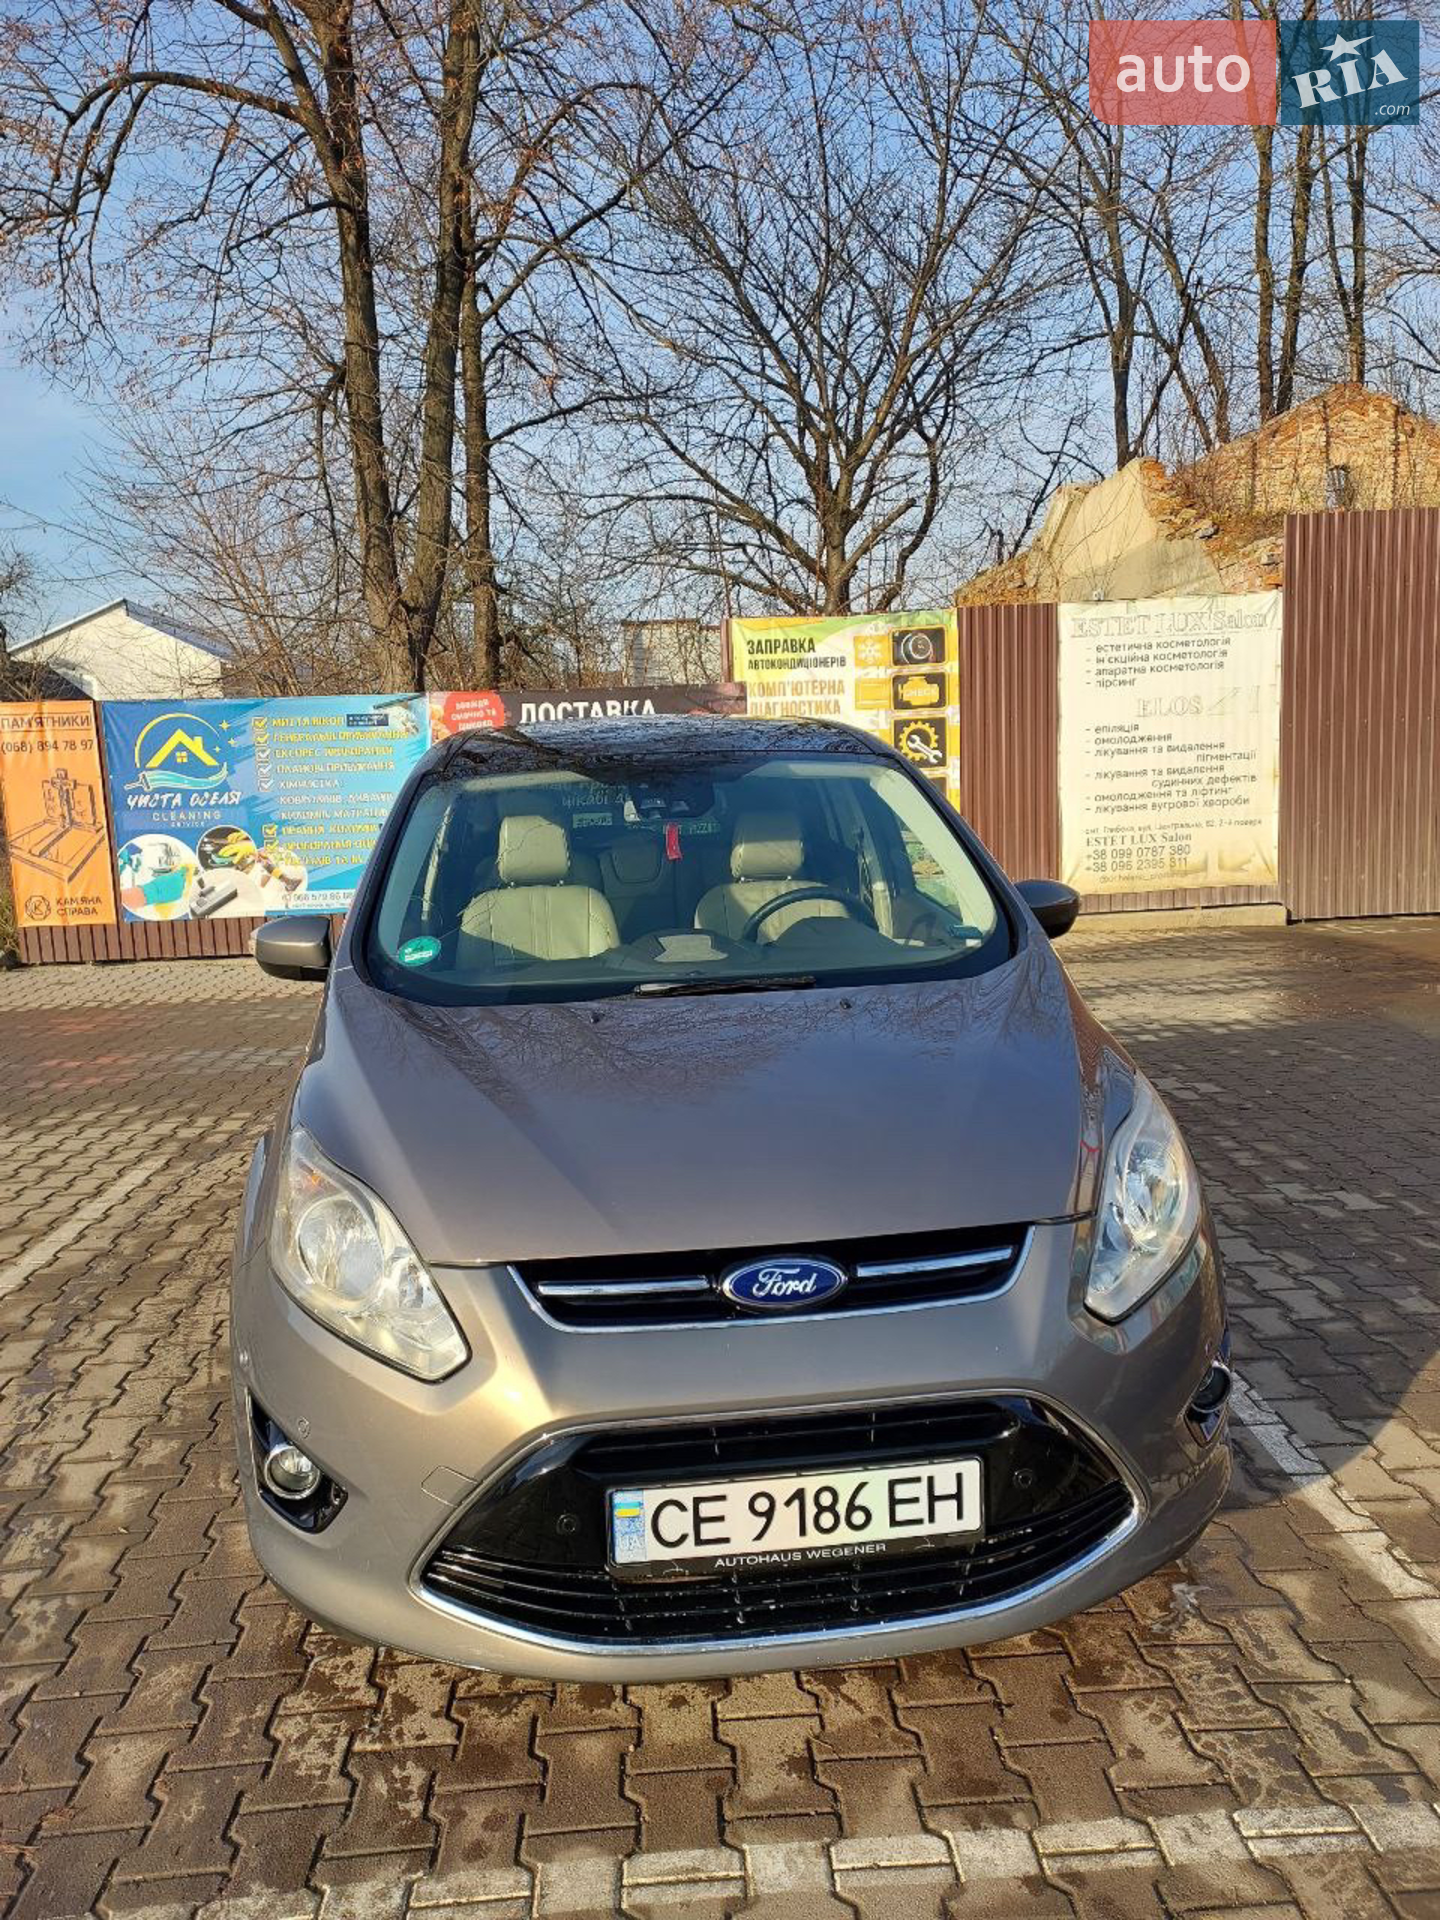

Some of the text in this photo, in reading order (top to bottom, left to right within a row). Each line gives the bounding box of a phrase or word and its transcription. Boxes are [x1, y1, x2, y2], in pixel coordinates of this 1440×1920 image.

[1071, 608, 1269, 638] ESTET LUX Salon
[746, 637, 816, 655] ЗАПРАВКА
[1095, 636, 1232, 653] естетична косметологія
[748, 656, 848, 670] АВТОКОНДИЦІОНЕРІВ
[1153, 648, 1228, 662] косметологія
[1094, 661, 1225, 679] апаратна косметологія
[749, 680, 845, 698] КОМП'ЮТЕРНА
[519, 698, 656, 724] ДОСТАВКА
[749, 699, 841, 717] ДІАГНОСТИКА
[0, 714, 90, 730] ПАМ'ЯТНИКИ
[1094, 724, 1140, 735] епіляція
[1, 739, 94, 754] (068) 894 78 97
[1094, 733, 1173, 746] омолодження
[1094, 741, 1226, 759] лікування та видалення
[1196, 750, 1257, 763] пігментації
[1094, 764, 1225, 781] лікування та видалення
[1151, 773, 1258, 789] судинних дефектів
[126, 791, 242, 811] ЧИСТА ОСЕЛЯ
[1094, 789, 1173, 802] омолодження
[1175, 788, 1188, 798] та
[1094, 802, 1149, 815] лікування
[1202, 795, 1250, 808] хвороби
[152, 810, 221, 822] CLEANING
[1085, 831, 1192, 847] ESTET LUX Salon
[1136, 845, 1166, 858] 0787
[56, 907, 98, 917] СПРАВА
[752, 1267, 817, 1297] Ford
[651, 1472, 964, 1549] CE 9186 EH
[714, 1543, 887, 1568] AUTOHAUS WEGENER
